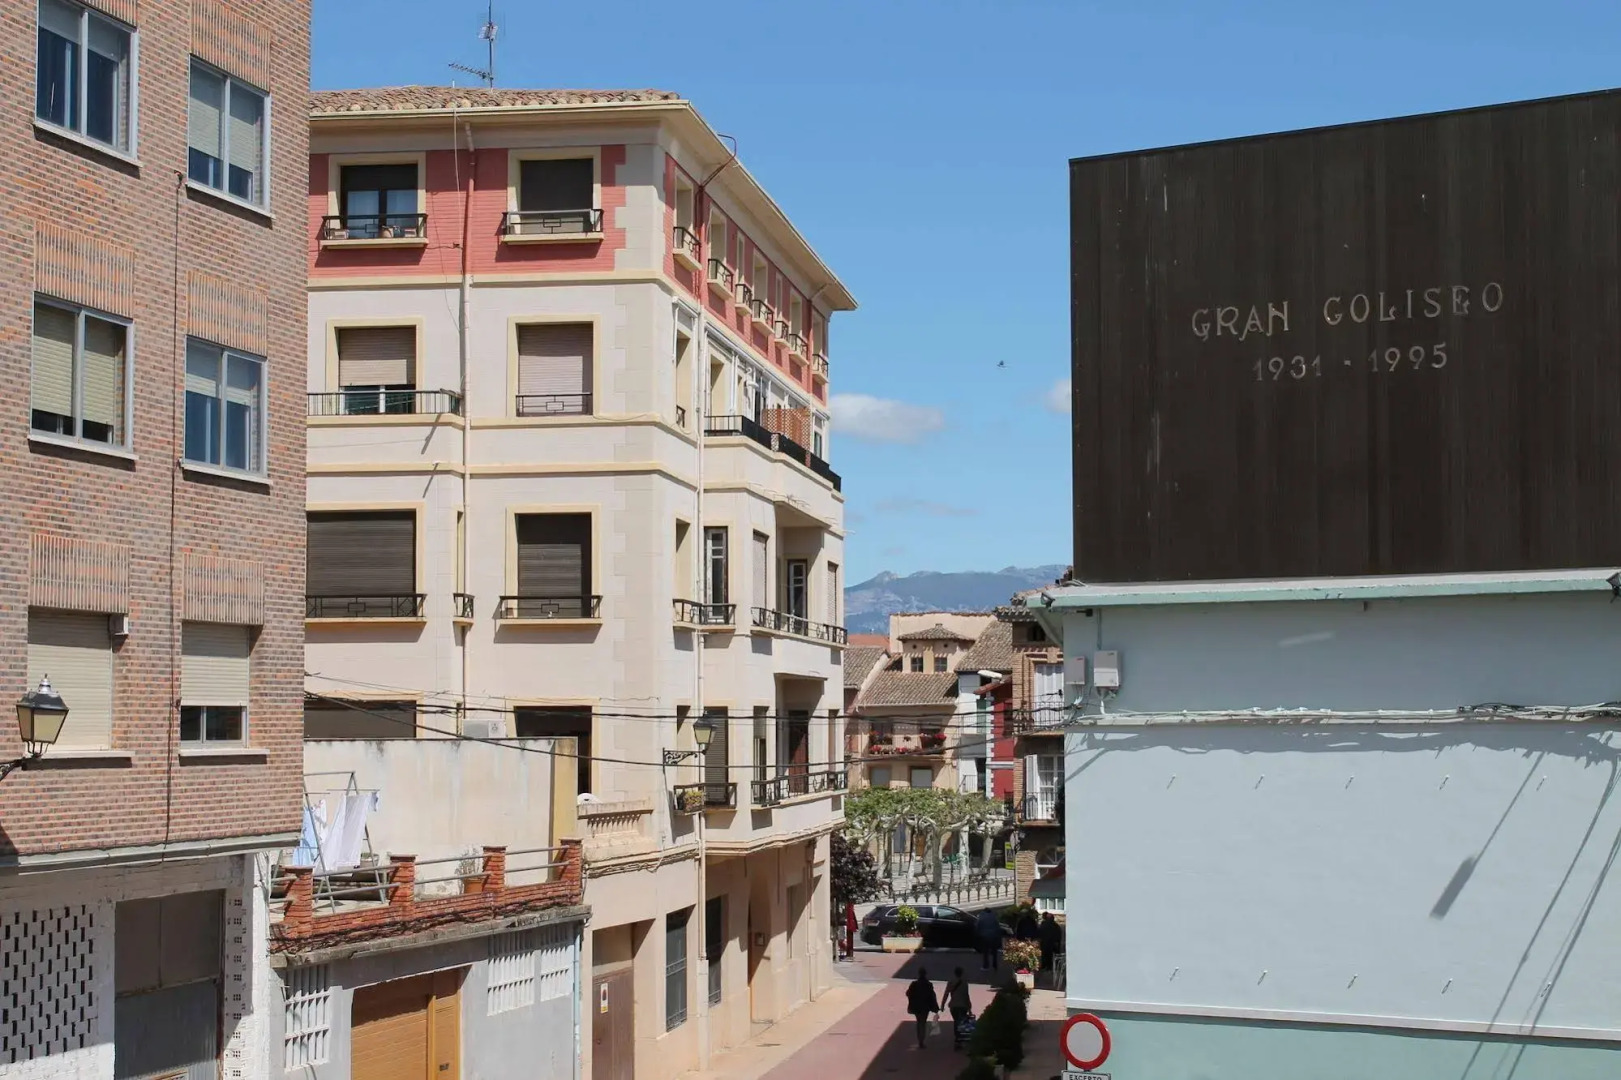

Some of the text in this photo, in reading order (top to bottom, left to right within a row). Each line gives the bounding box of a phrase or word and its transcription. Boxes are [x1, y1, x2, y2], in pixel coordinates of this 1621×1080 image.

[1191, 301, 1289, 342] GRAN
[1253, 354, 1322, 381] 1931
[1368, 342, 1448, 372] 1995
